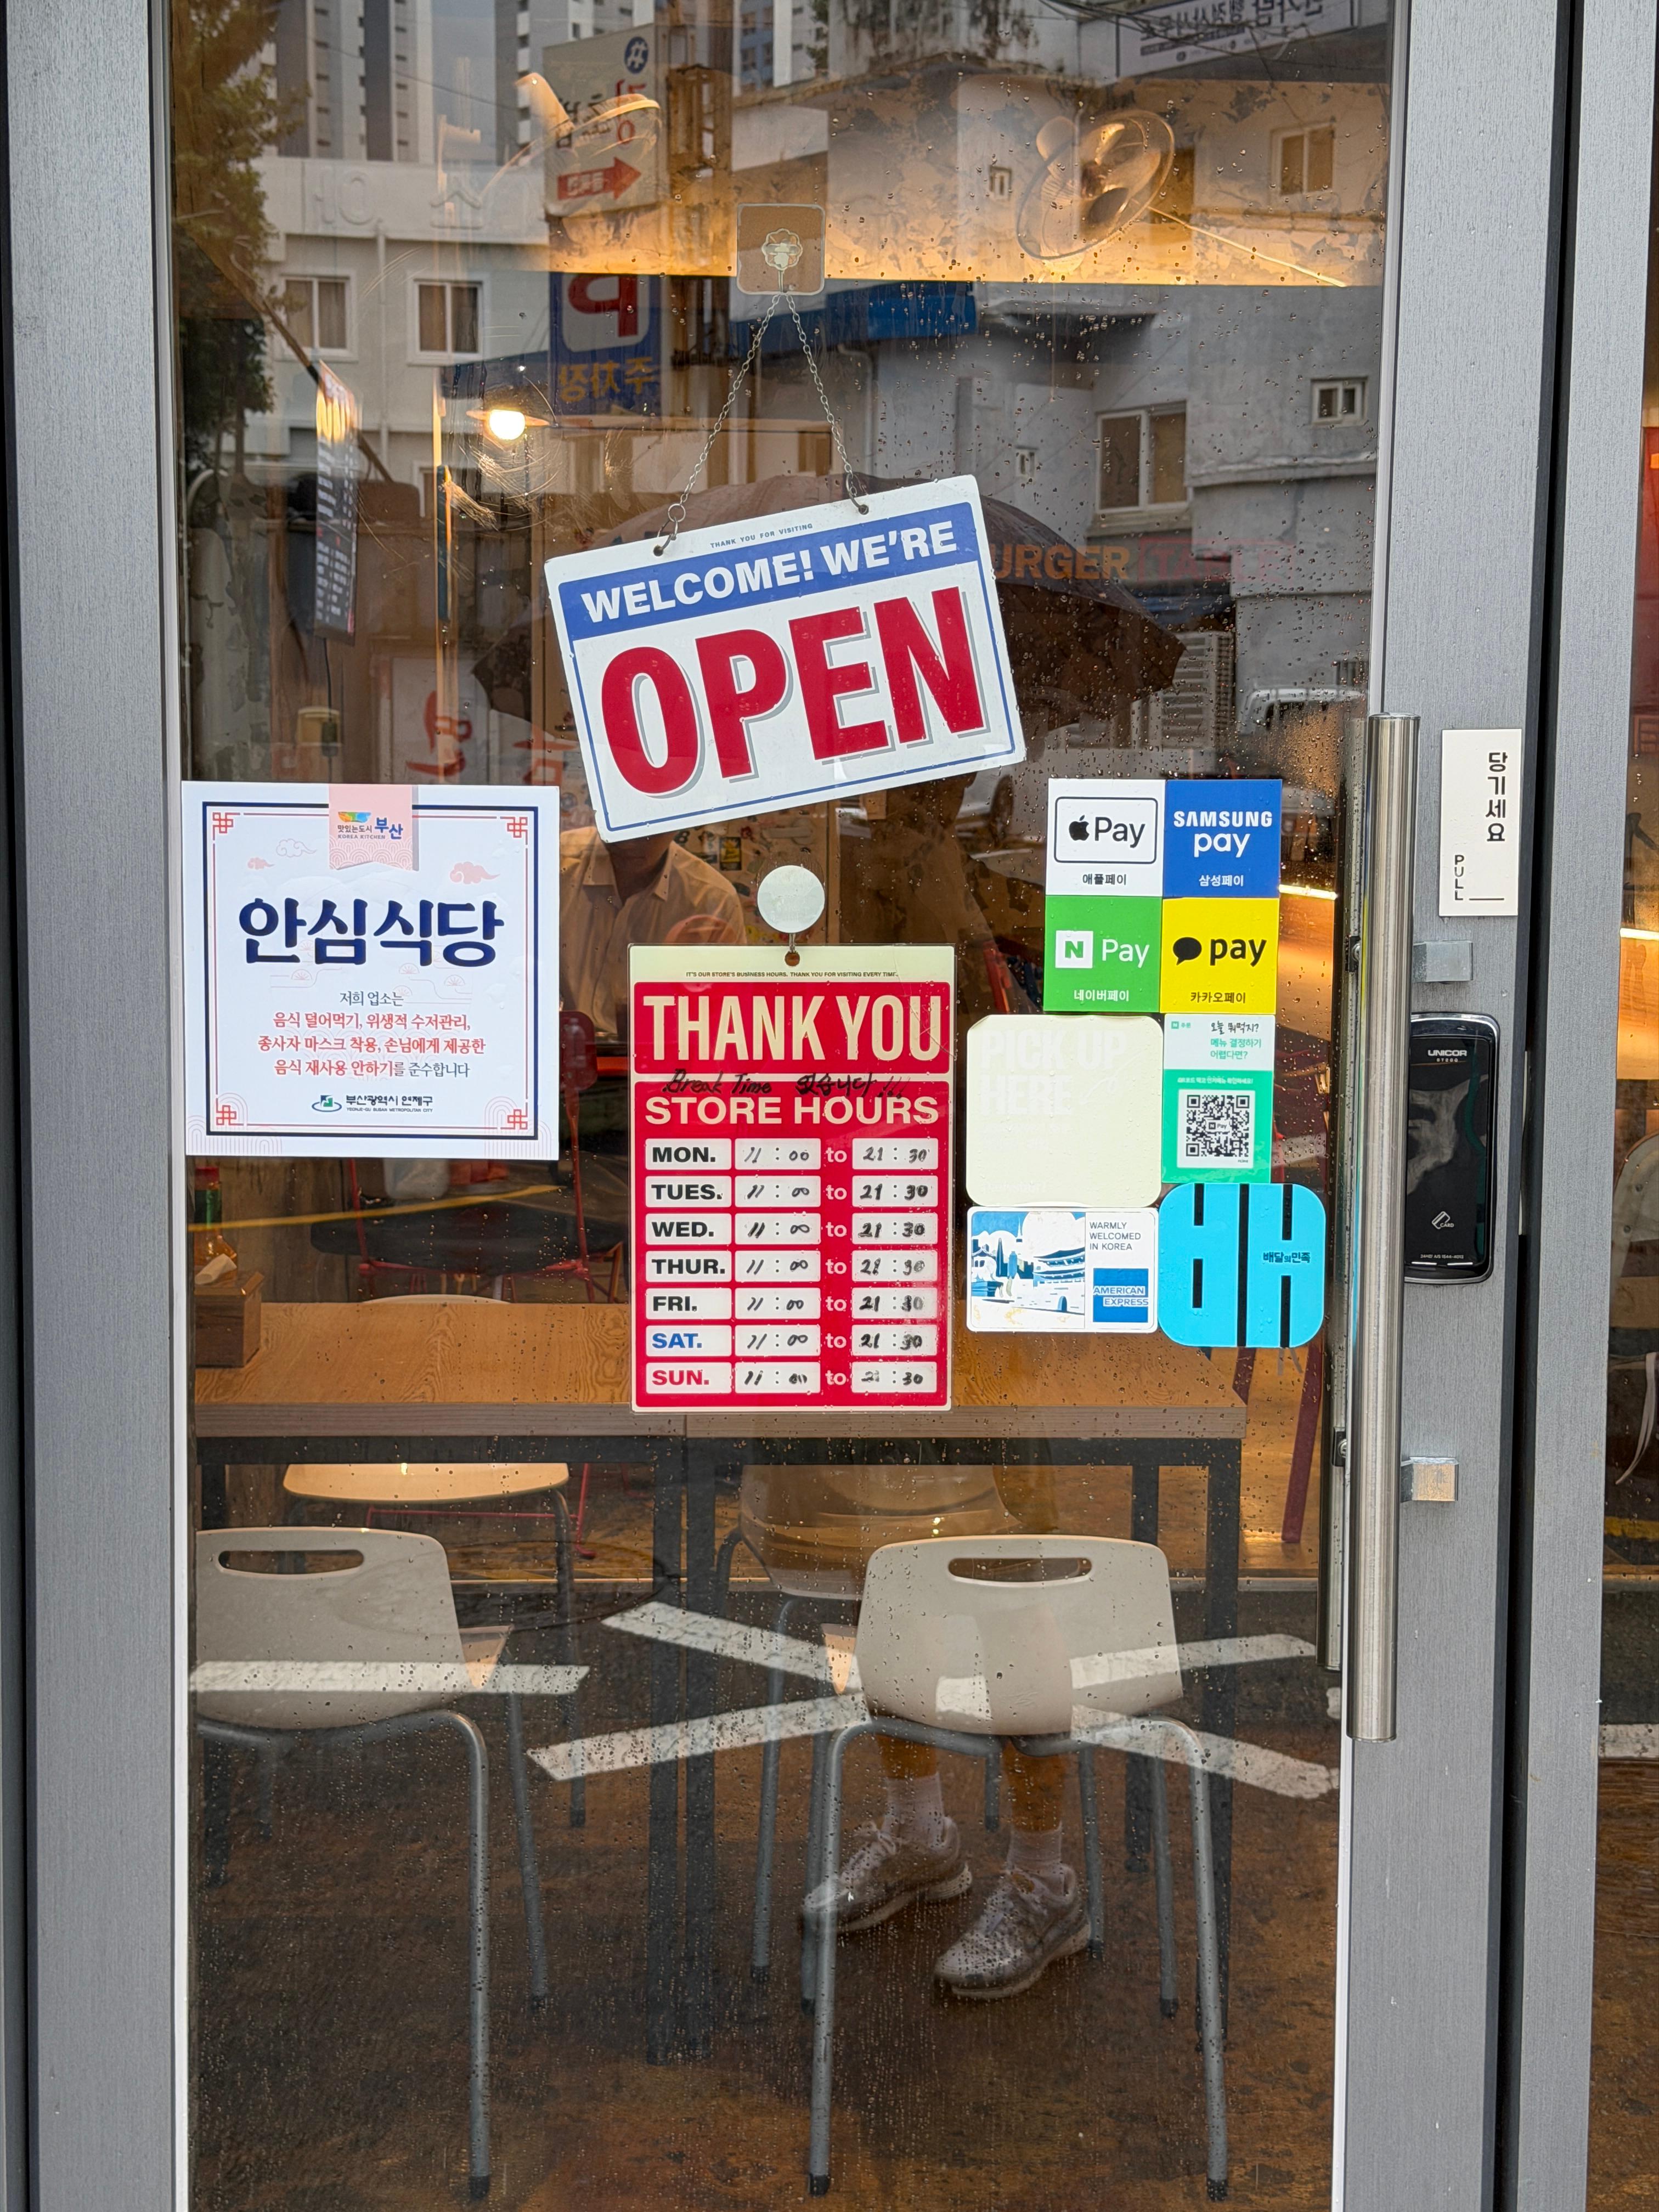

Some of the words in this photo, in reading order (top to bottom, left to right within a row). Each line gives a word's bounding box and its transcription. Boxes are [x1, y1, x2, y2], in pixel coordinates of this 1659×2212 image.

[710, 538, 736, 549] THANK
[779, 523, 813, 535] VISITING
[992, 544, 1130, 580] URGER
[580, 552, 812, 623] WELCOME!
[820, 521, 957, 576] WE'RE
[601, 586, 989, 795] OPEN
[1486, 752, 1508, 842] 당기세요
[337, 825, 373, 833] 맛있는도시
[374, 817, 403, 839] 부산
[1173, 811, 1272, 827] SAMSUNG
[1094, 817, 1146, 848] Pay
[1194, 832, 1250, 857] pay
[1082, 873, 1127, 885] 애플페이
[1199, 874, 1244, 887] 삼성페이
[1454, 855, 1464, 901] PULL
[239, 898, 505, 967] 안심식당
[1102, 939, 1150, 968] Pay
[1210, 938, 1267, 967] pay
[340, 991, 364, 1007] 저희
[367, 991, 404, 1007] 업소는
[1074, 990, 1129, 1002] 네이버페이
[1190, 991, 1246, 1003] 카카오페이
[273, 1012, 301, 1028] 음식
[305, 1012, 362, 1029] 덜어먹기,
[366, 1013, 407, 1029] 위생적
[410, 1014, 471, 1031] 수저관리,
[643, 996, 825, 1060] THANK
[835, 996, 941, 1060] YOU
[1211, 1020, 1224, 1035] 오늘
[1228, 1022, 1259, 1034] 뭐먹지?
[258, 1036, 301, 1052] 종사자
[304, 1036, 346, 1052] 마스크
[350, 1036, 381, 1053] 착용,
[384, 1037, 439, 1054] 손님에게
[443, 1038, 487, 1054] 제공한
[979, 1029, 1067, 1070] PICK
[1079, 1029, 1125, 1069] UP
[1210, 1038, 1227, 1047] 메뉴
[1229, 1039, 1261, 1048] 결정하기
[1210, 1050, 1248, 1059] 어렵다면?
[274, 1059, 301, 1075] 음식
[306, 1060, 347, 1076] 재사용
[351, 1061, 405, 1077] 안하기를
[408, 1062, 470, 1078] 준수합니다
[731, 1073, 772, 1094] Time
[346, 1095, 398, 1105] 부산광역시
[402, 1096, 433, 1106] 연제구
[980, 1075, 1072, 1115] HERE
[645, 1097, 782, 1124] STORE
[794, 1097, 939, 1124] HOURS
[652, 1147, 715, 1162] MON.
[826, 1148, 847, 1161] to
[651, 1184, 723, 1199] TUES.
[826, 1186, 847, 1199] to
[652, 1222, 714, 1237] WED.
[826, 1223, 847, 1236] to
[1263, 1251, 1311, 1263] 배달의민족
[652, 1259, 725, 1274] THUR.
[826, 1260, 847, 1273] to
[653, 1296, 697, 1311] FRI.
[825, 1297, 847, 1311] to
[652, 1333, 702, 1348] SAT.
[825, 1334, 847, 1347] to
[652, 1370, 709, 1385] SUN.
[825, 1371, 847, 1385] to
